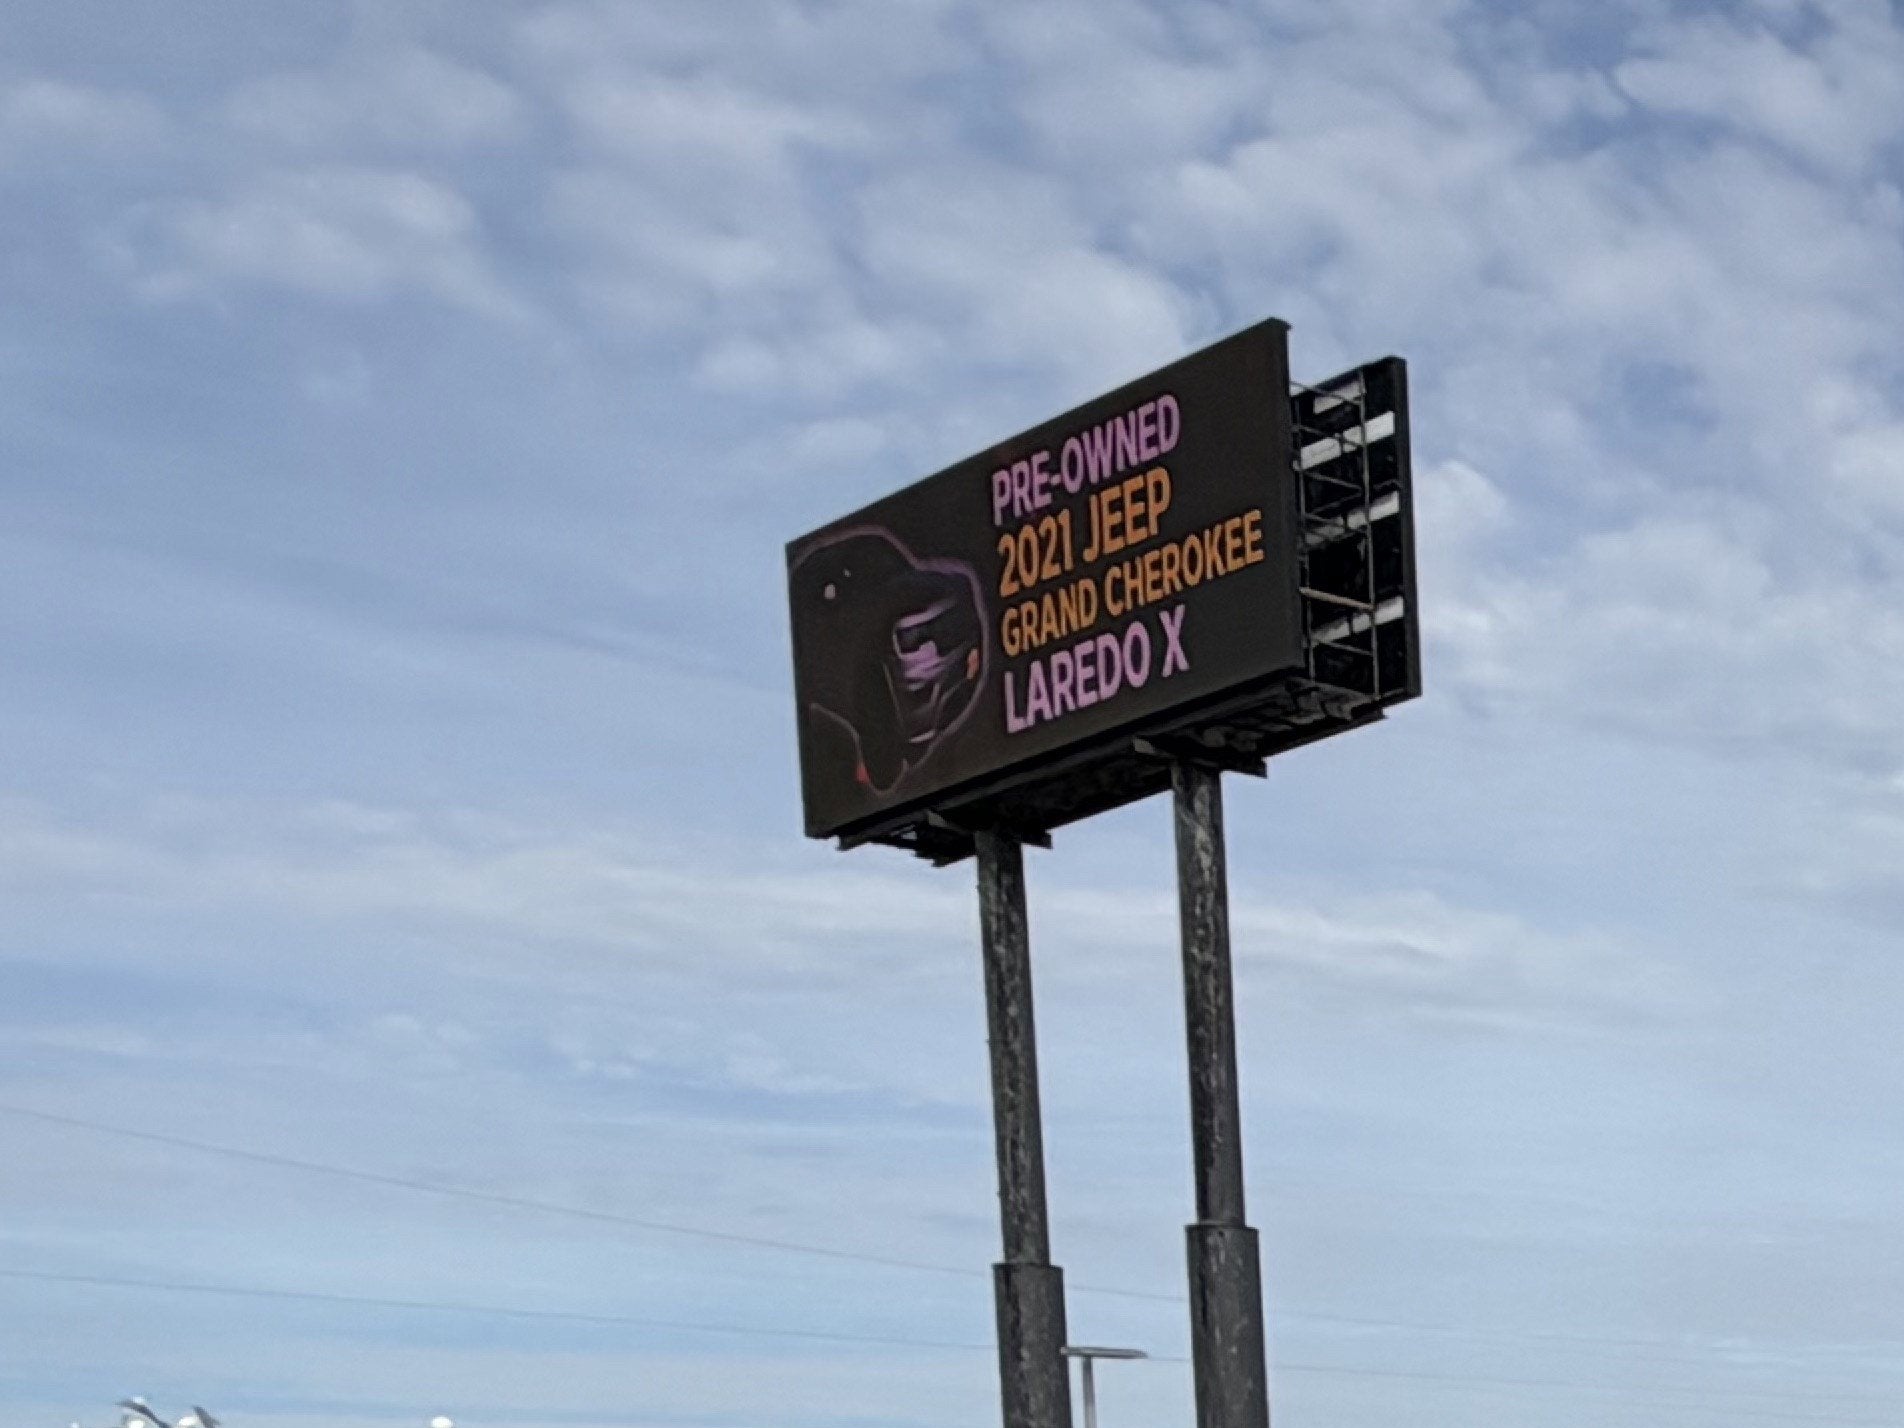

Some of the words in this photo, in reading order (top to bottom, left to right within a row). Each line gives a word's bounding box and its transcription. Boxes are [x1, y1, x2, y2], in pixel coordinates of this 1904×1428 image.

[991, 394, 1180, 525] PRE-OWNED
[998, 509, 1073, 598] 2021
[1081, 467, 1171, 562] JEEP
[1002, 578, 1098, 656] GRAND
[1103, 509, 1264, 617] CHEROKEE
[1004, 621, 1152, 734] LAREDO
[1159, 604, 1190, 678] X
